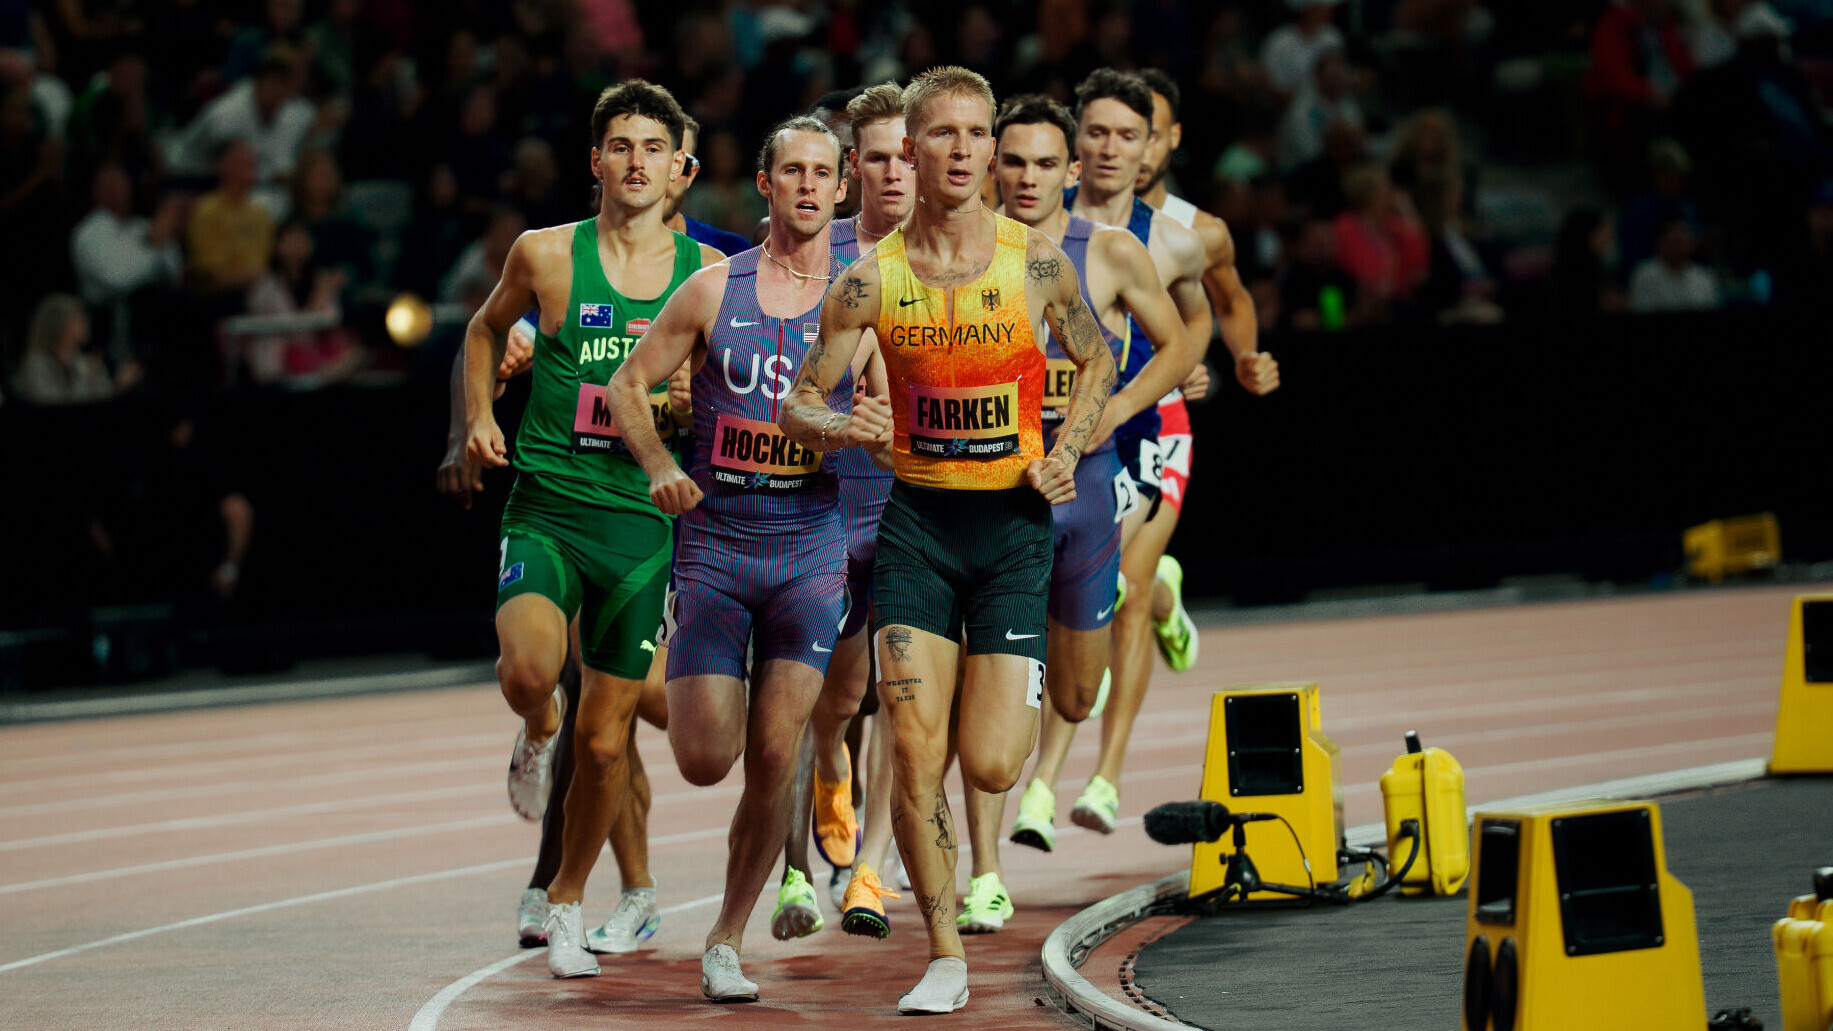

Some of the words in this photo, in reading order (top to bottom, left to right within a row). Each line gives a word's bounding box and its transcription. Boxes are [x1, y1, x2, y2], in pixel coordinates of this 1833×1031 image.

[890, 322, 1015, 347] GERMANY
[579, 336, 640, 365] AUST
[917, 394, 1010, 431] FARKEN
[580, 436, 612, 449] ULTIMATE
[916, 440, 945, 453] ULTIMATE
[969, 442, 1005, 454] BUDAPEST
[716, 471, 746, 485] ULTIMATE
[769, 478, 803, 489] BUDAPEST
[886, 678, 922, 686] WHATEVER
[1036, 663, 1045, 702] 3
